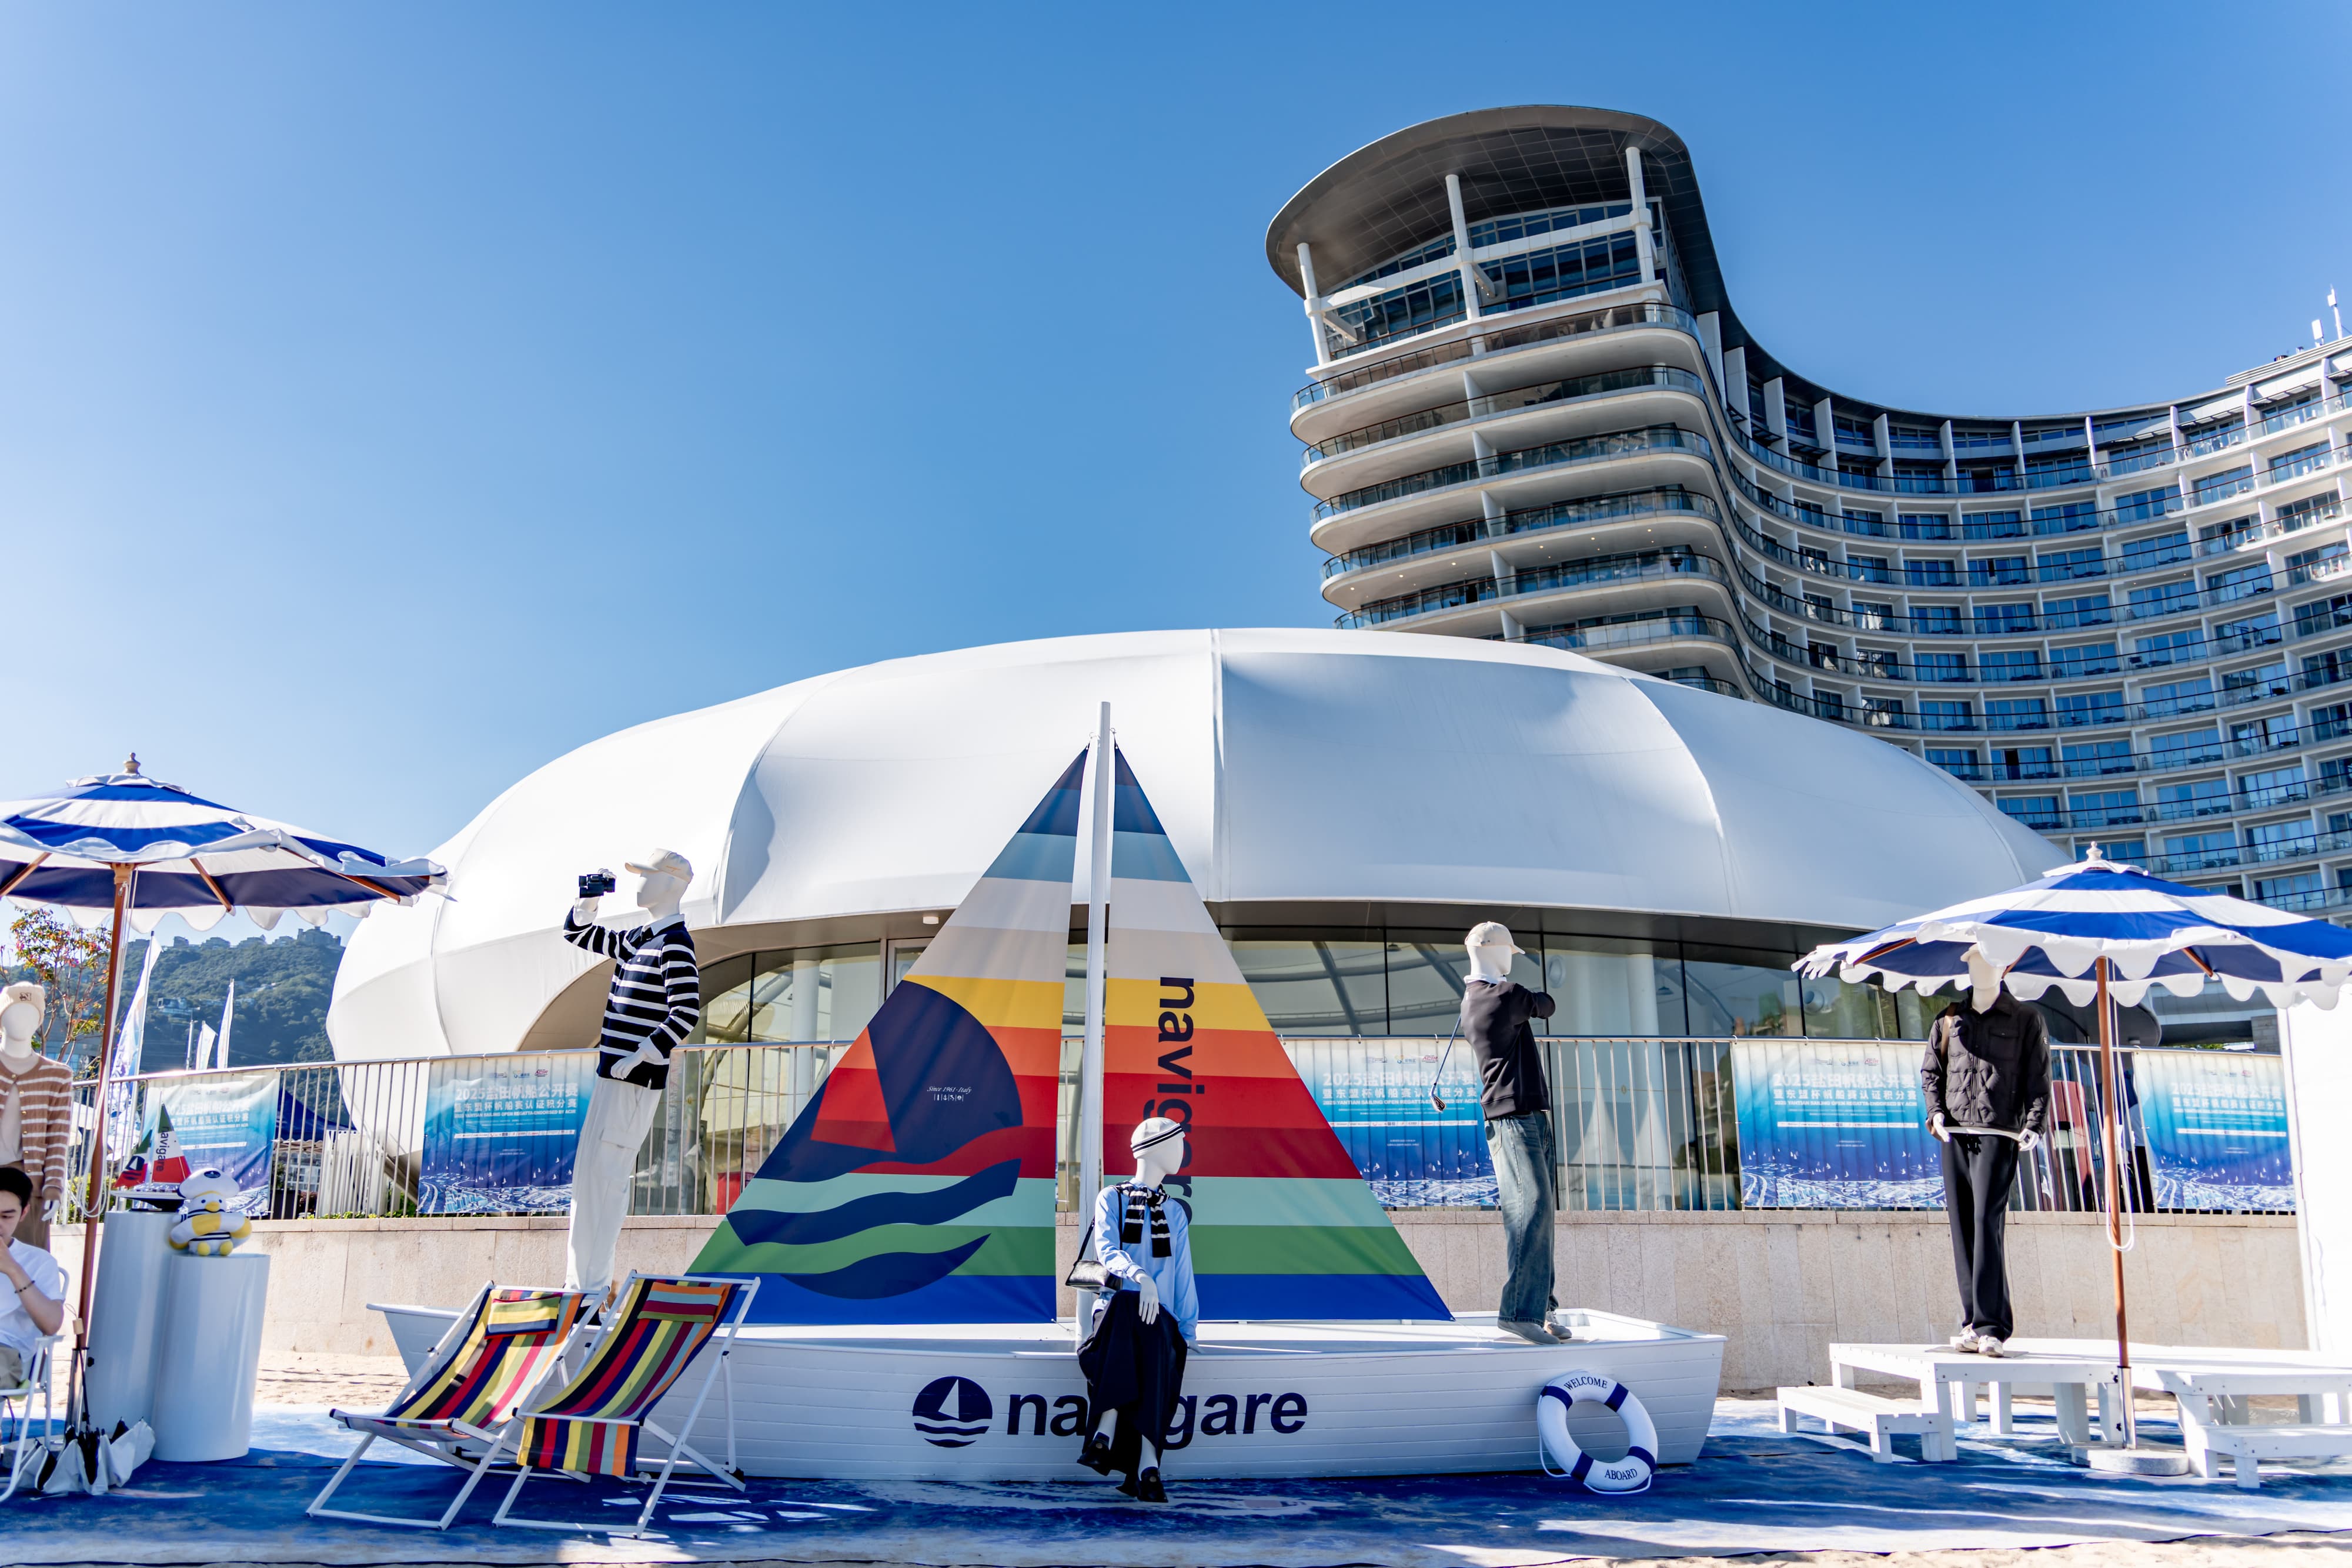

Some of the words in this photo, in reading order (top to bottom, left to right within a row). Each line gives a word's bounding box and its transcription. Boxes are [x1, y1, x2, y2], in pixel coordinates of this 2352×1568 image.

[456, 1083, 578, 1101] 2025盐田帆船公开赛
[1143, 977, 1205, 1224] navigr
[156, 1126, 170, 1172] navigare
[1564, 1376, 1608, 1391] WELCOME
[1007, 1392, 1308, 1450] nagare
[1605, 1468, 1638, 1480] ABOARD
